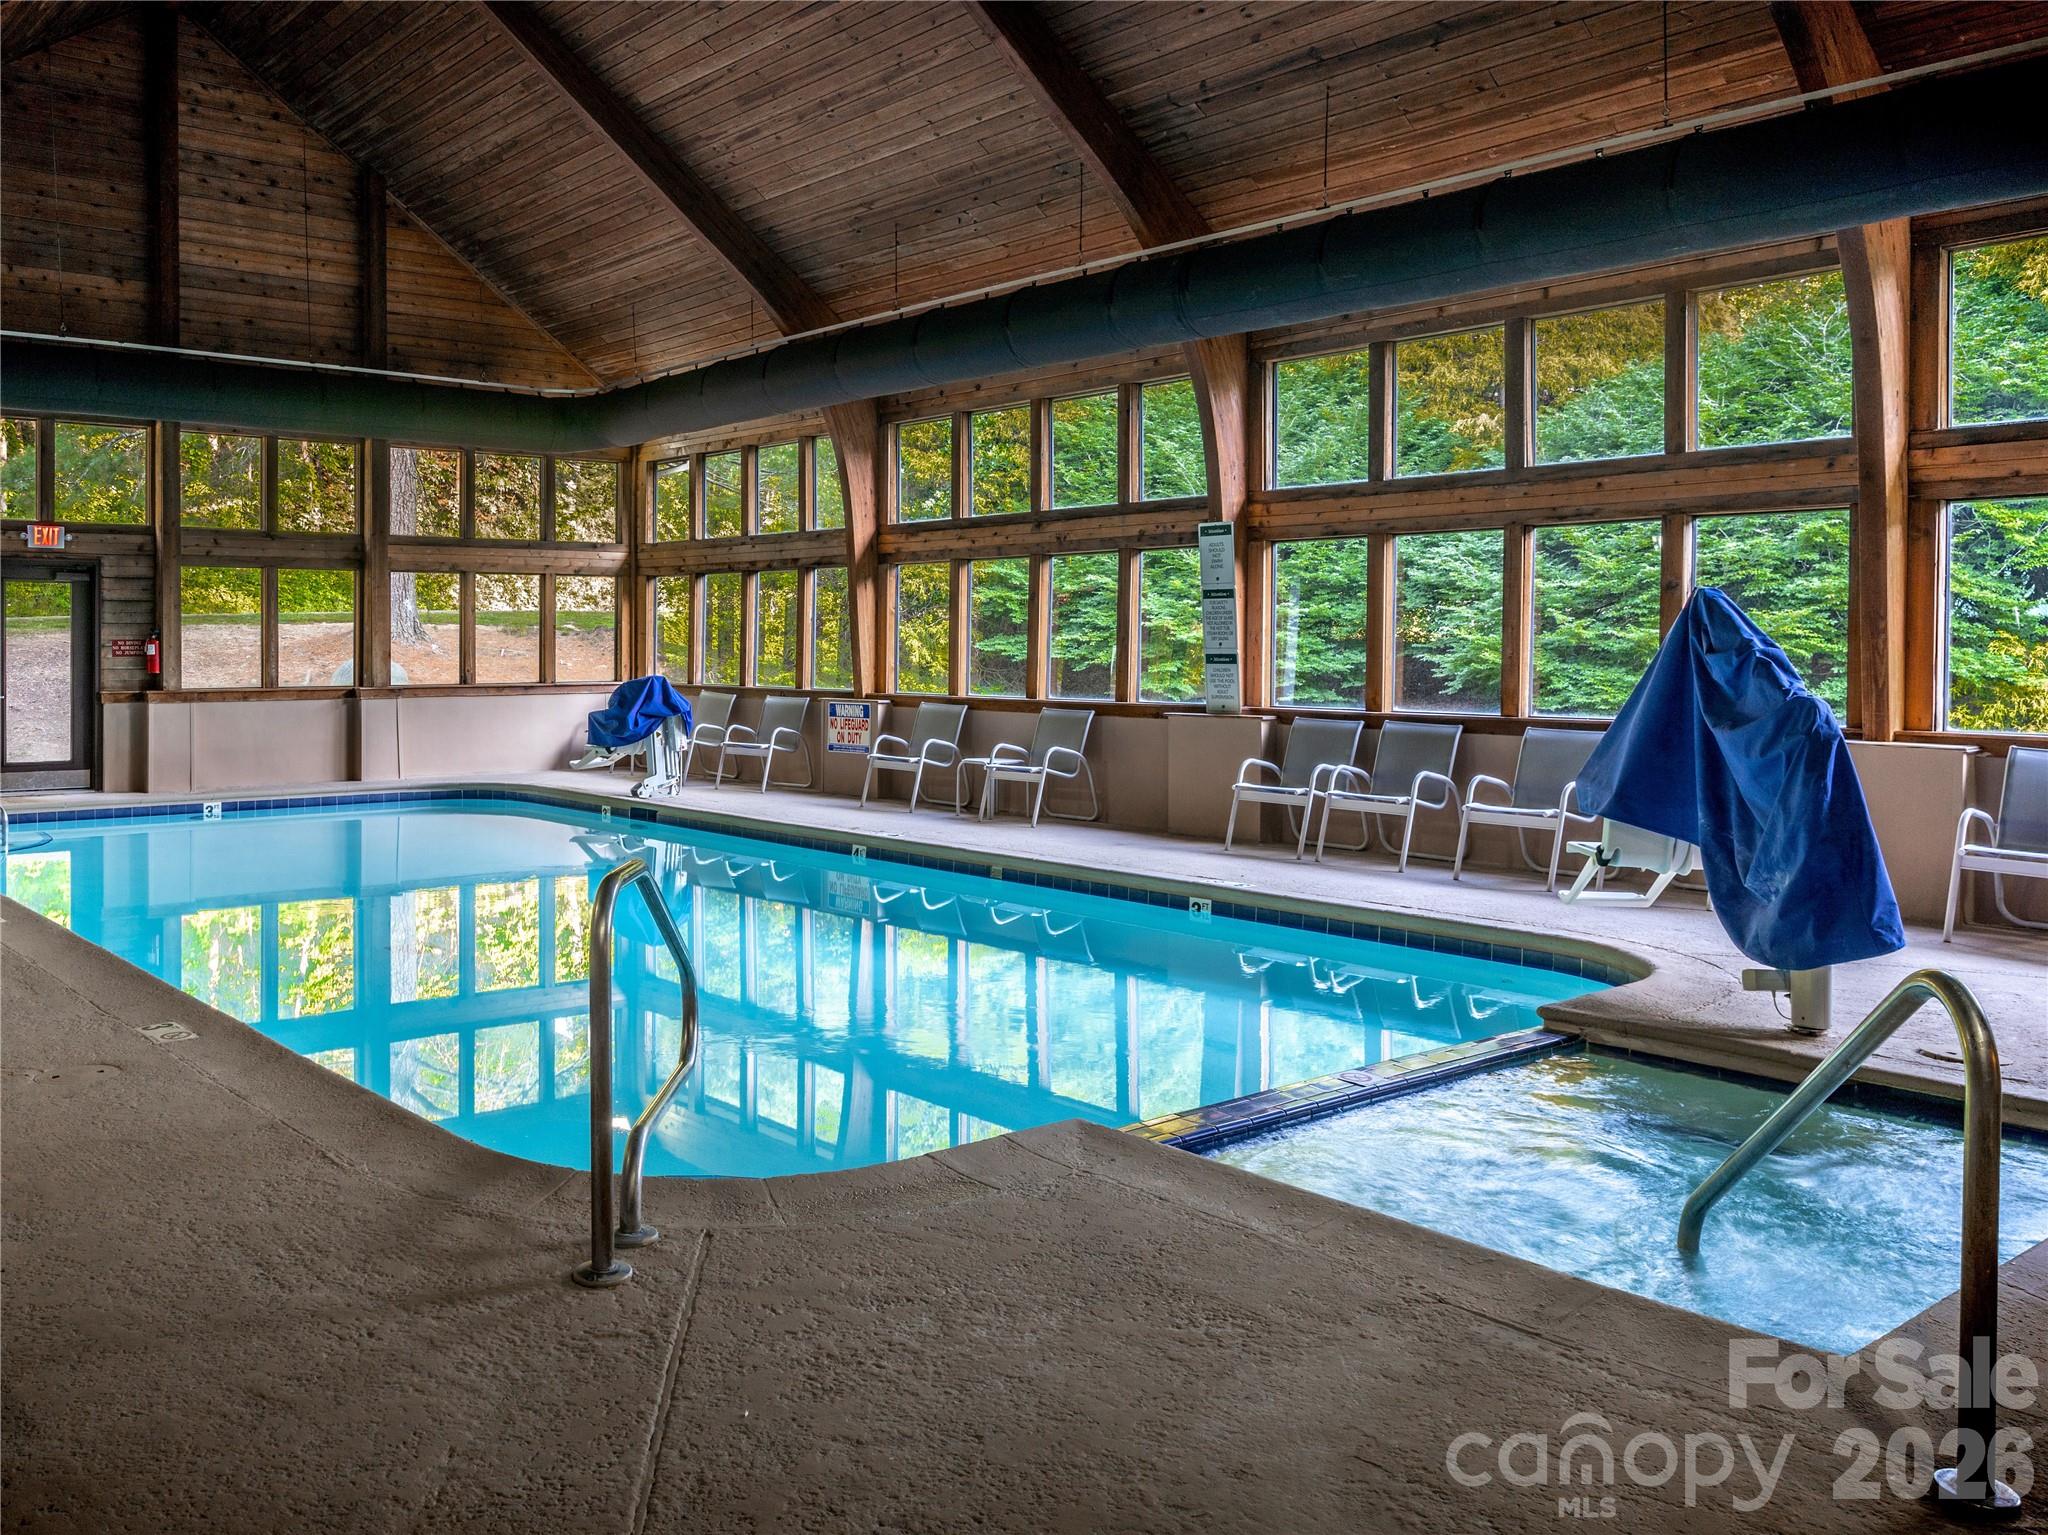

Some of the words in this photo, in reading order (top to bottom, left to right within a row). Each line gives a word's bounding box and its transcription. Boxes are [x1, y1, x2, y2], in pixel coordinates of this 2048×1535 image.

[34, 527, 60, 546] EXIT
[835, 704, 864, 718] WARNING
[830, 718, 838, 730] NO
[840, 718, 869, 731] LIFEGUARD
[837, 731, 845, 743] ON
[847, 732, 862, 744] DUTY
